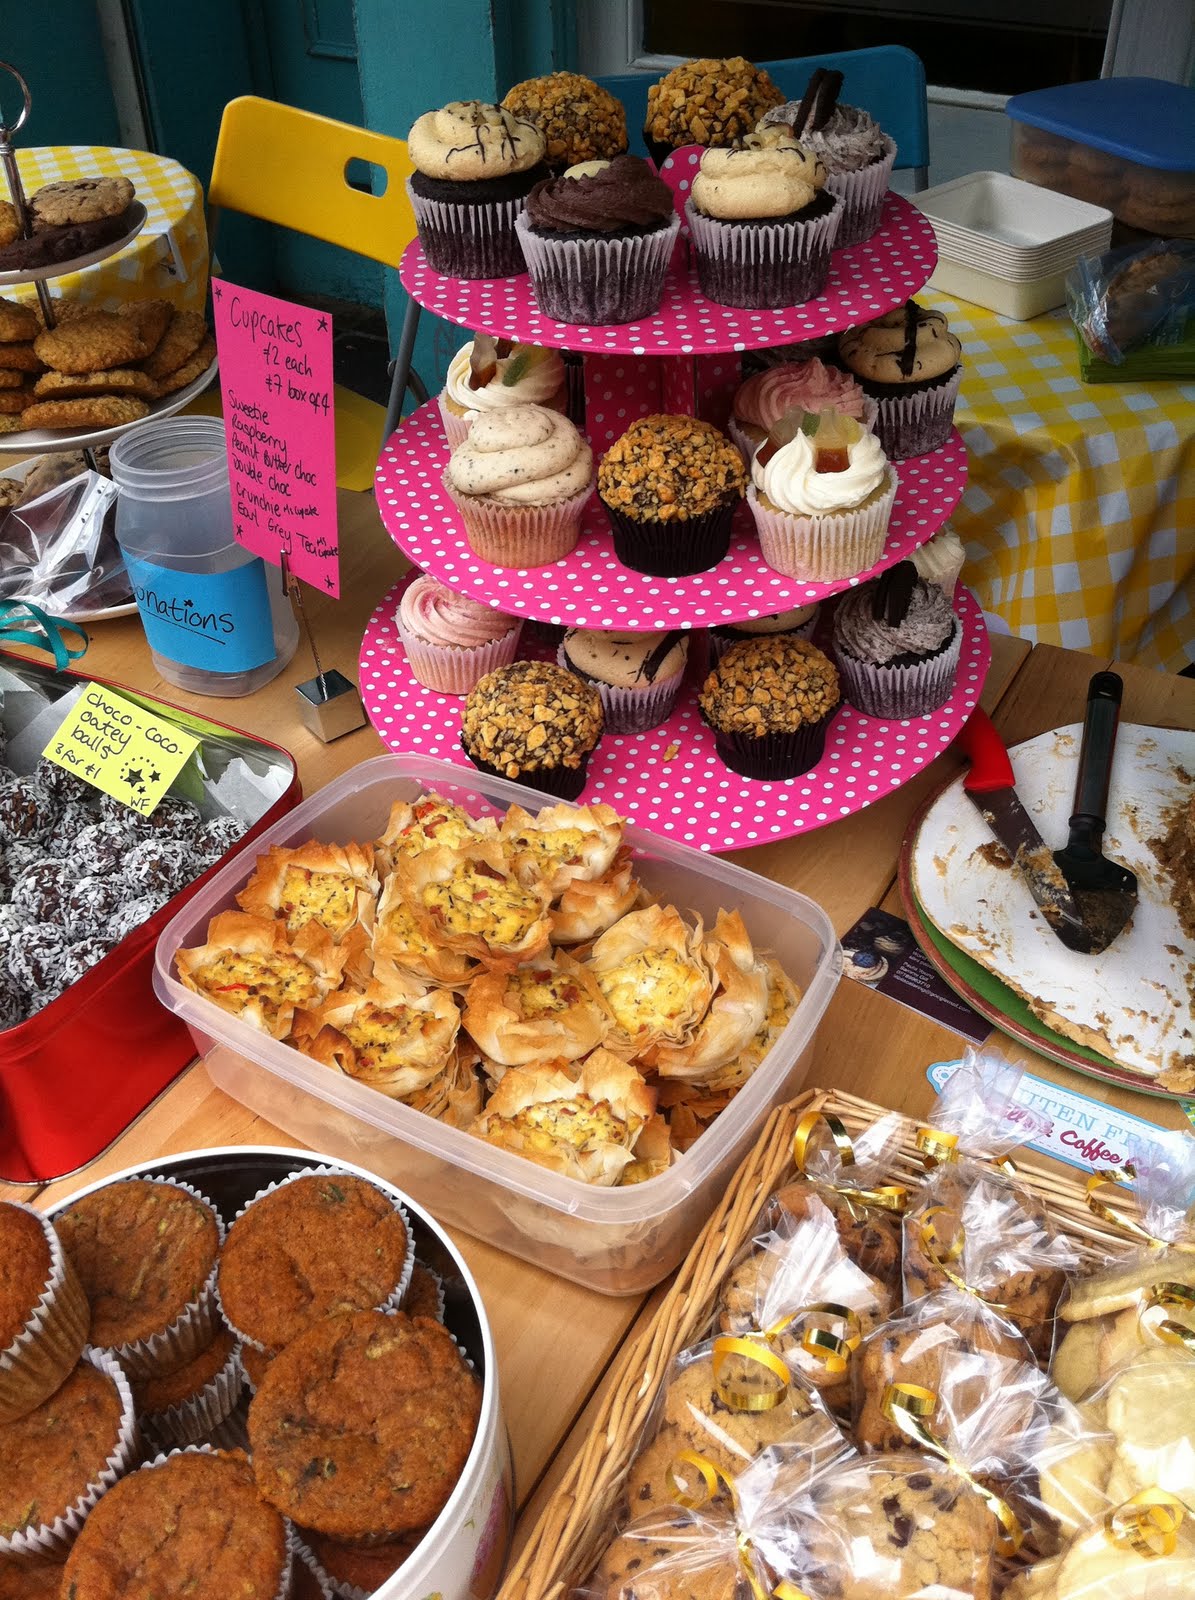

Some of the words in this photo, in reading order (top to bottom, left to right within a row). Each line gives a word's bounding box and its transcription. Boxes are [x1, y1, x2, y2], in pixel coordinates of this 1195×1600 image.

[230, 296, 303, 348] Cupcakes
[263, 342, 280, 365] £2
[285, 354, 312, 377] each
[228, 389, 270, 425] Sweetie
[265, 374, 283, 395] £7
[288, 379, 306, 402] box
[309, 392, 321, 414] of
[321, 393, 330, 416] 4
[232, 413, 288, 466] Raspberry
[232, 432, 259, 461] Peanut
[231, 452, 263, 485] Double
[237, 502, 259, 527] Earl
[268, 518, 292, 556] Grey
[296, 532, 318, 557] Tea
[135, 585, 235, 633] onations
[71, 725, 109, 760] balls
[55, 743, 65, 755] 3
[61, 750, 84, 766] for
[84, 763, 101, 779] £1
[130, 796, 151, 811] WF
[1059, 1129, 1124, 1167] Coffee
